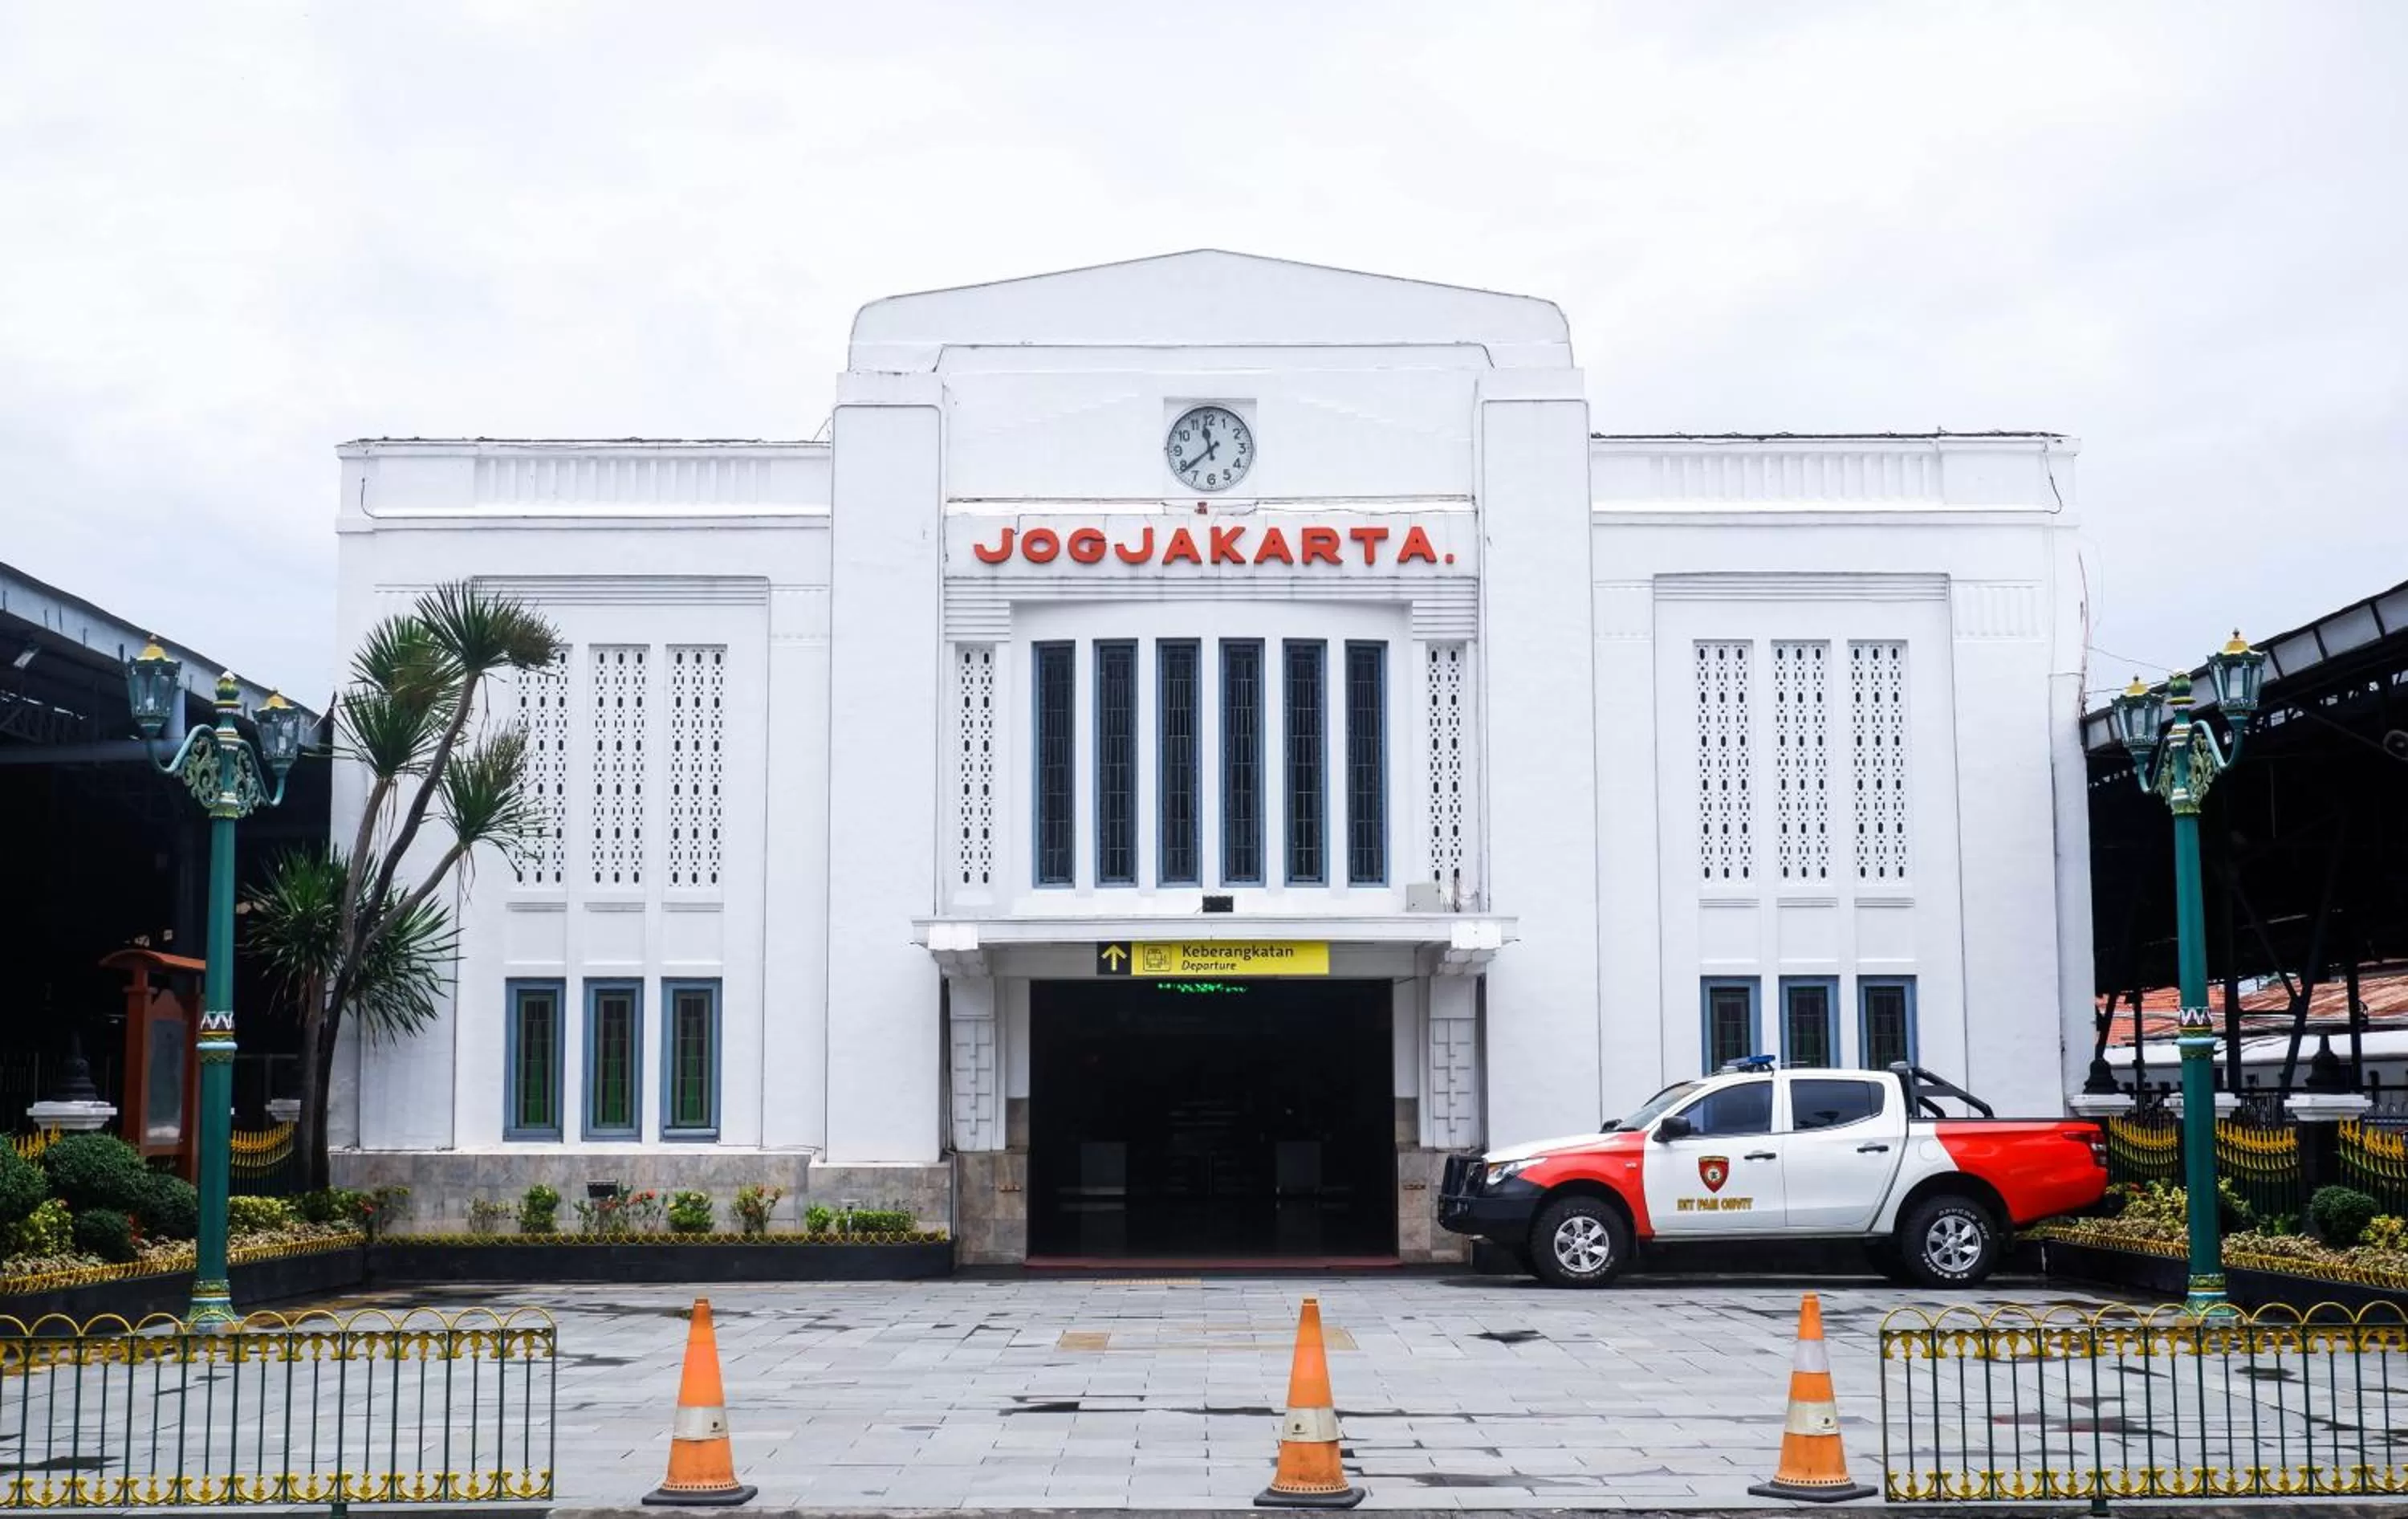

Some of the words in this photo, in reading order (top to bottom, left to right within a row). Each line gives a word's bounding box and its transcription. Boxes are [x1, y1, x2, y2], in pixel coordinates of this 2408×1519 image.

[1190, 418, 1199, 430] 11
[1204, 414, 1214, 426] 12
[1222, 418, 1226, 429] 1
[1178, 430, 1190, 442] 10
[1232, 428, 1241, 439] 2
[1173, 445, 1182, 456] 9
[1238, 442, 1246, 454] 3
[1179, 460, 1187, 472] 8
[1232, 458, 1241, 468] 4
[1191, 470, 1199, 481] 7
[1206, 473, 1216, 485] 6
[1222, 469, 1231, 480] 5
[973, 526, 1456, 564] JOGJAKARTA.
[1182, 943, 1294, 961] Keberangkatan
[1181, 959, 1237, 972] Departure
